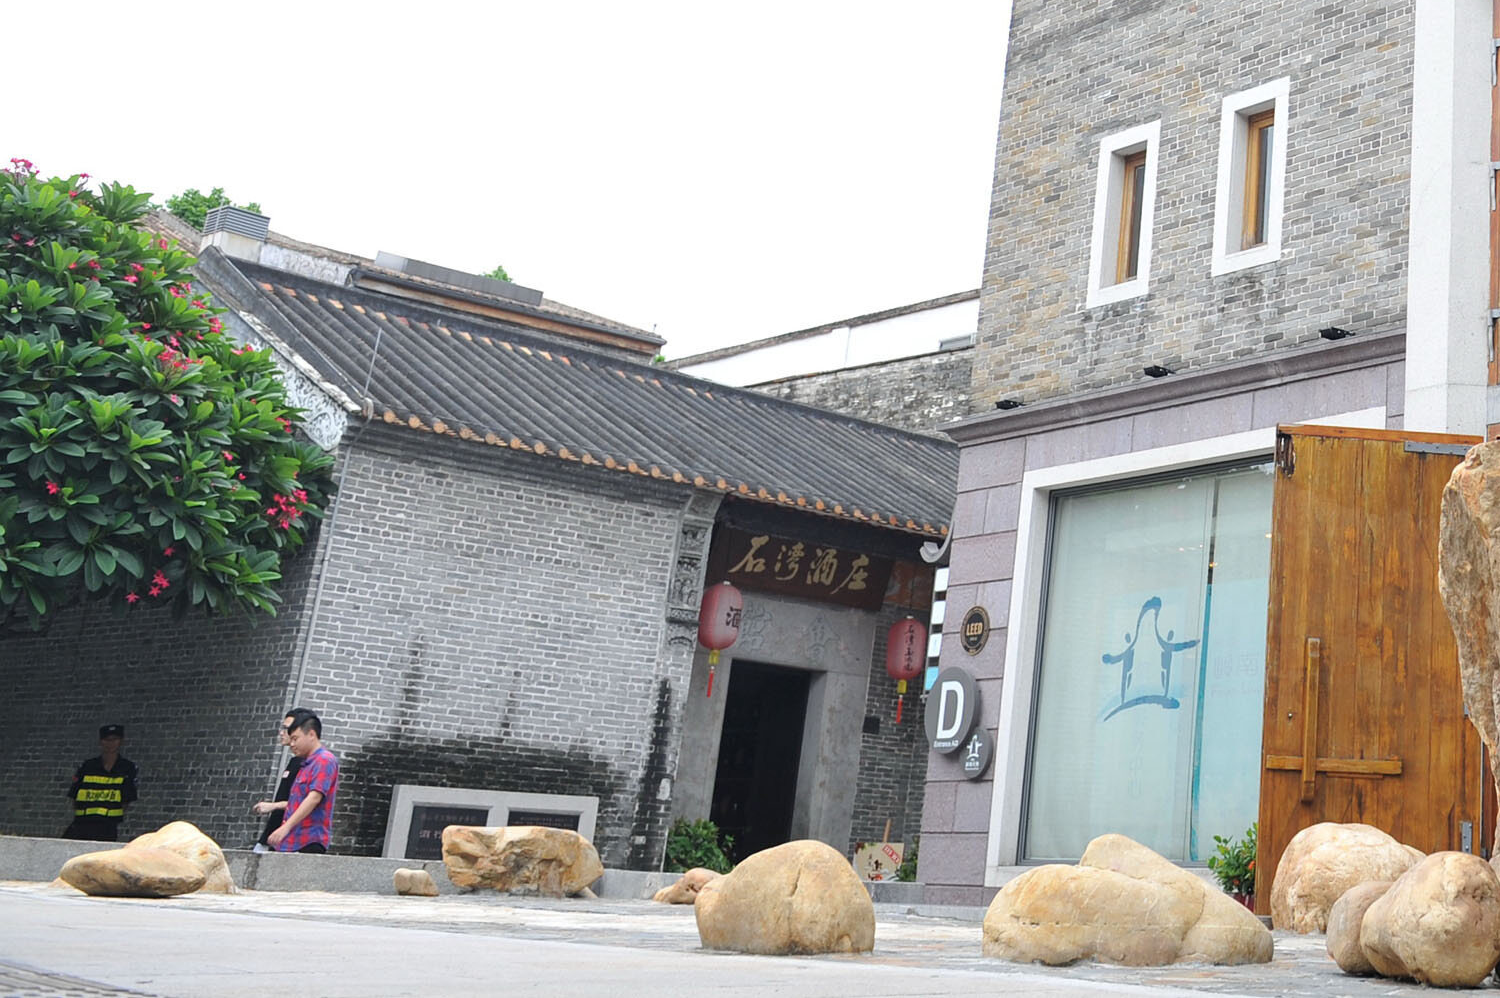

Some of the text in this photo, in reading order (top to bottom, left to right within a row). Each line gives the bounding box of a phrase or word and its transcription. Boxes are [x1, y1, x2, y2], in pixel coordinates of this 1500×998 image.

[728, 535, 870, 594] 石湾酒庄
[966, 622, 983, 636] LEED
[936, 680, 965, 740] D
